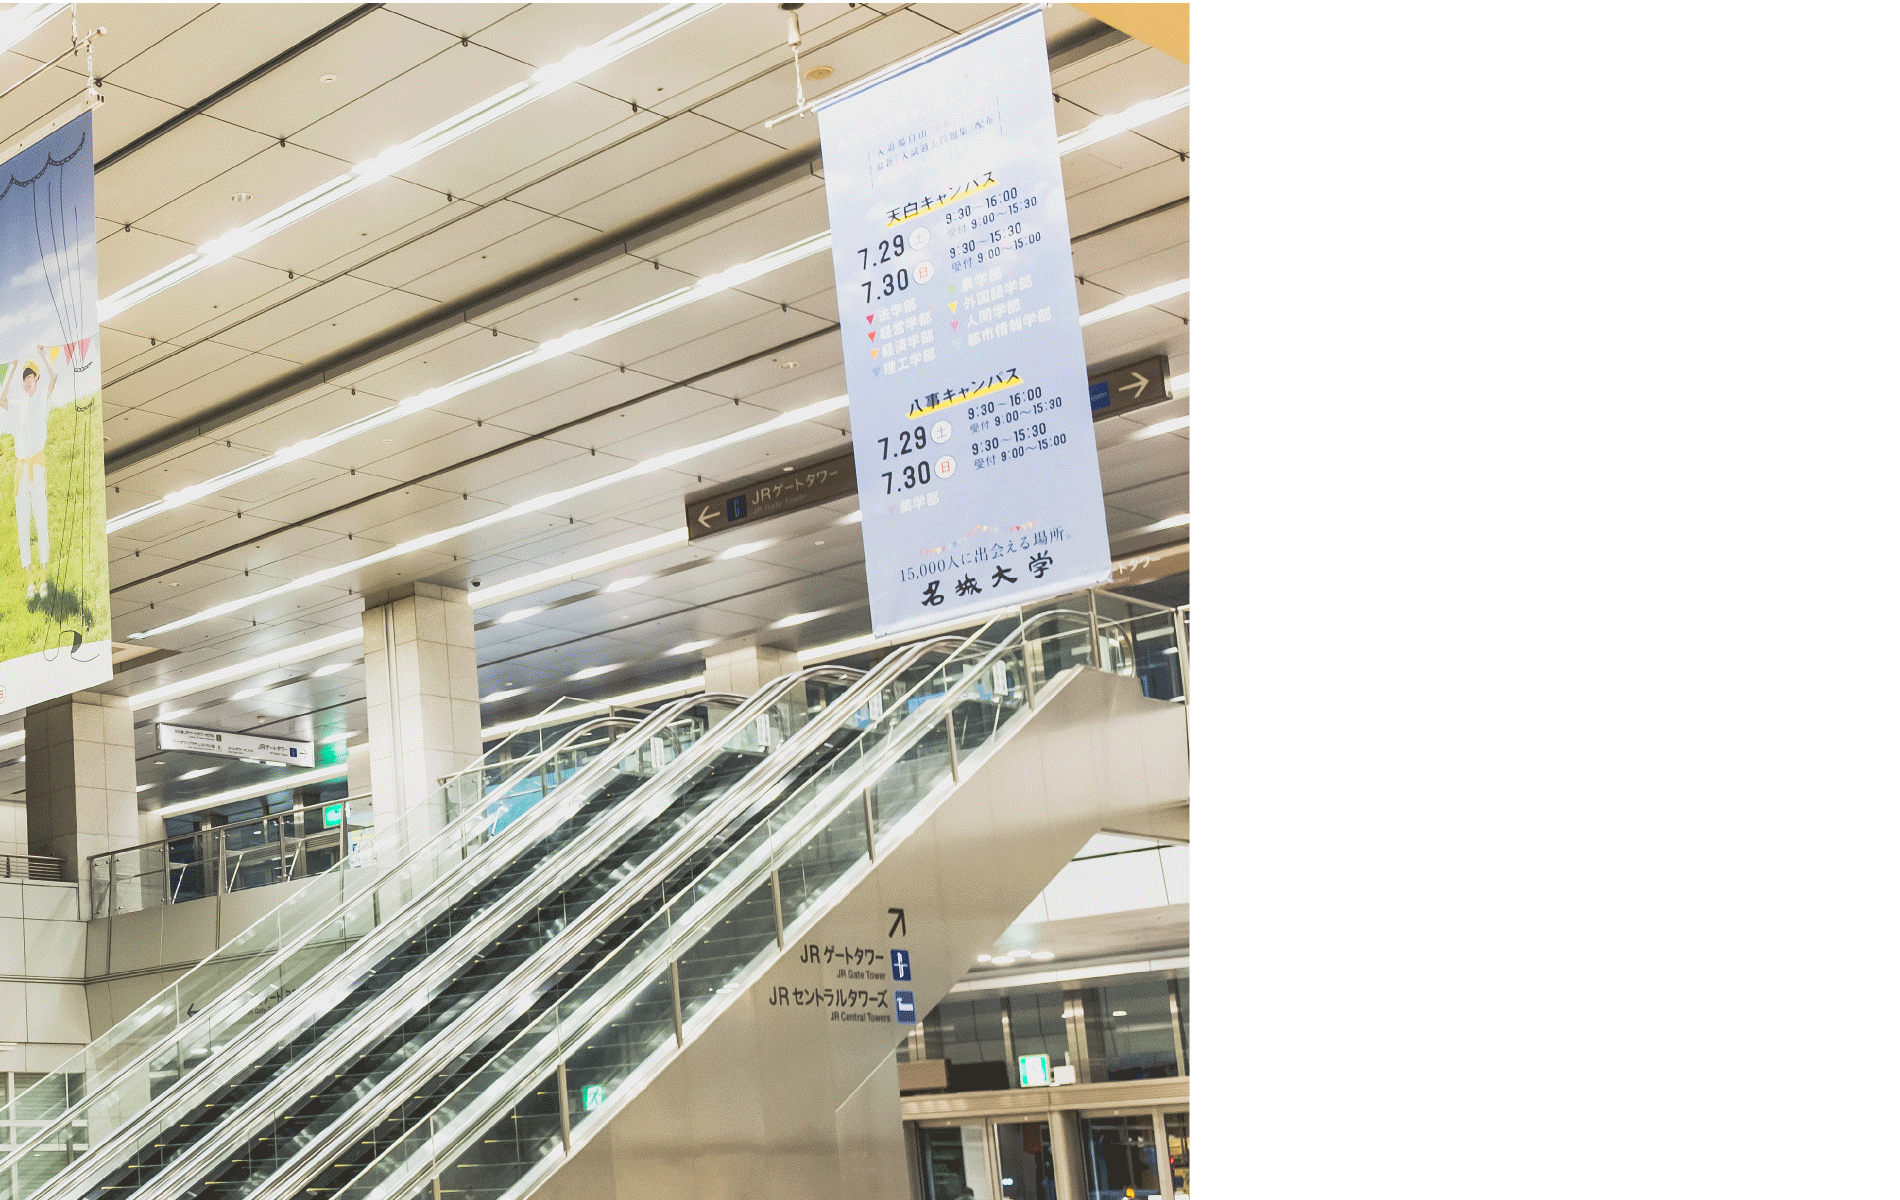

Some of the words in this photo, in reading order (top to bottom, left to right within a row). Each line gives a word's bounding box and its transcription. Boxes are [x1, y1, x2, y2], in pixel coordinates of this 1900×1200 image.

[886, 171, 996, 226] 天白キャンパス
[857, 234, 905, 270] 7.29
[861, 268, 909, 304] 7.30
[967, 299, 1021, 329] 人間学部
[882, 346, 936, 375] 理工学部
[909, 367, 1019, 416] 八事キャンパス
[878, 426, 927, 460] 7.29
[752, 470, 838, 505] JRゲートタワー
[881, 460, 931, 494] 7.30
[921, 550, 1053, 607] 名城大学
